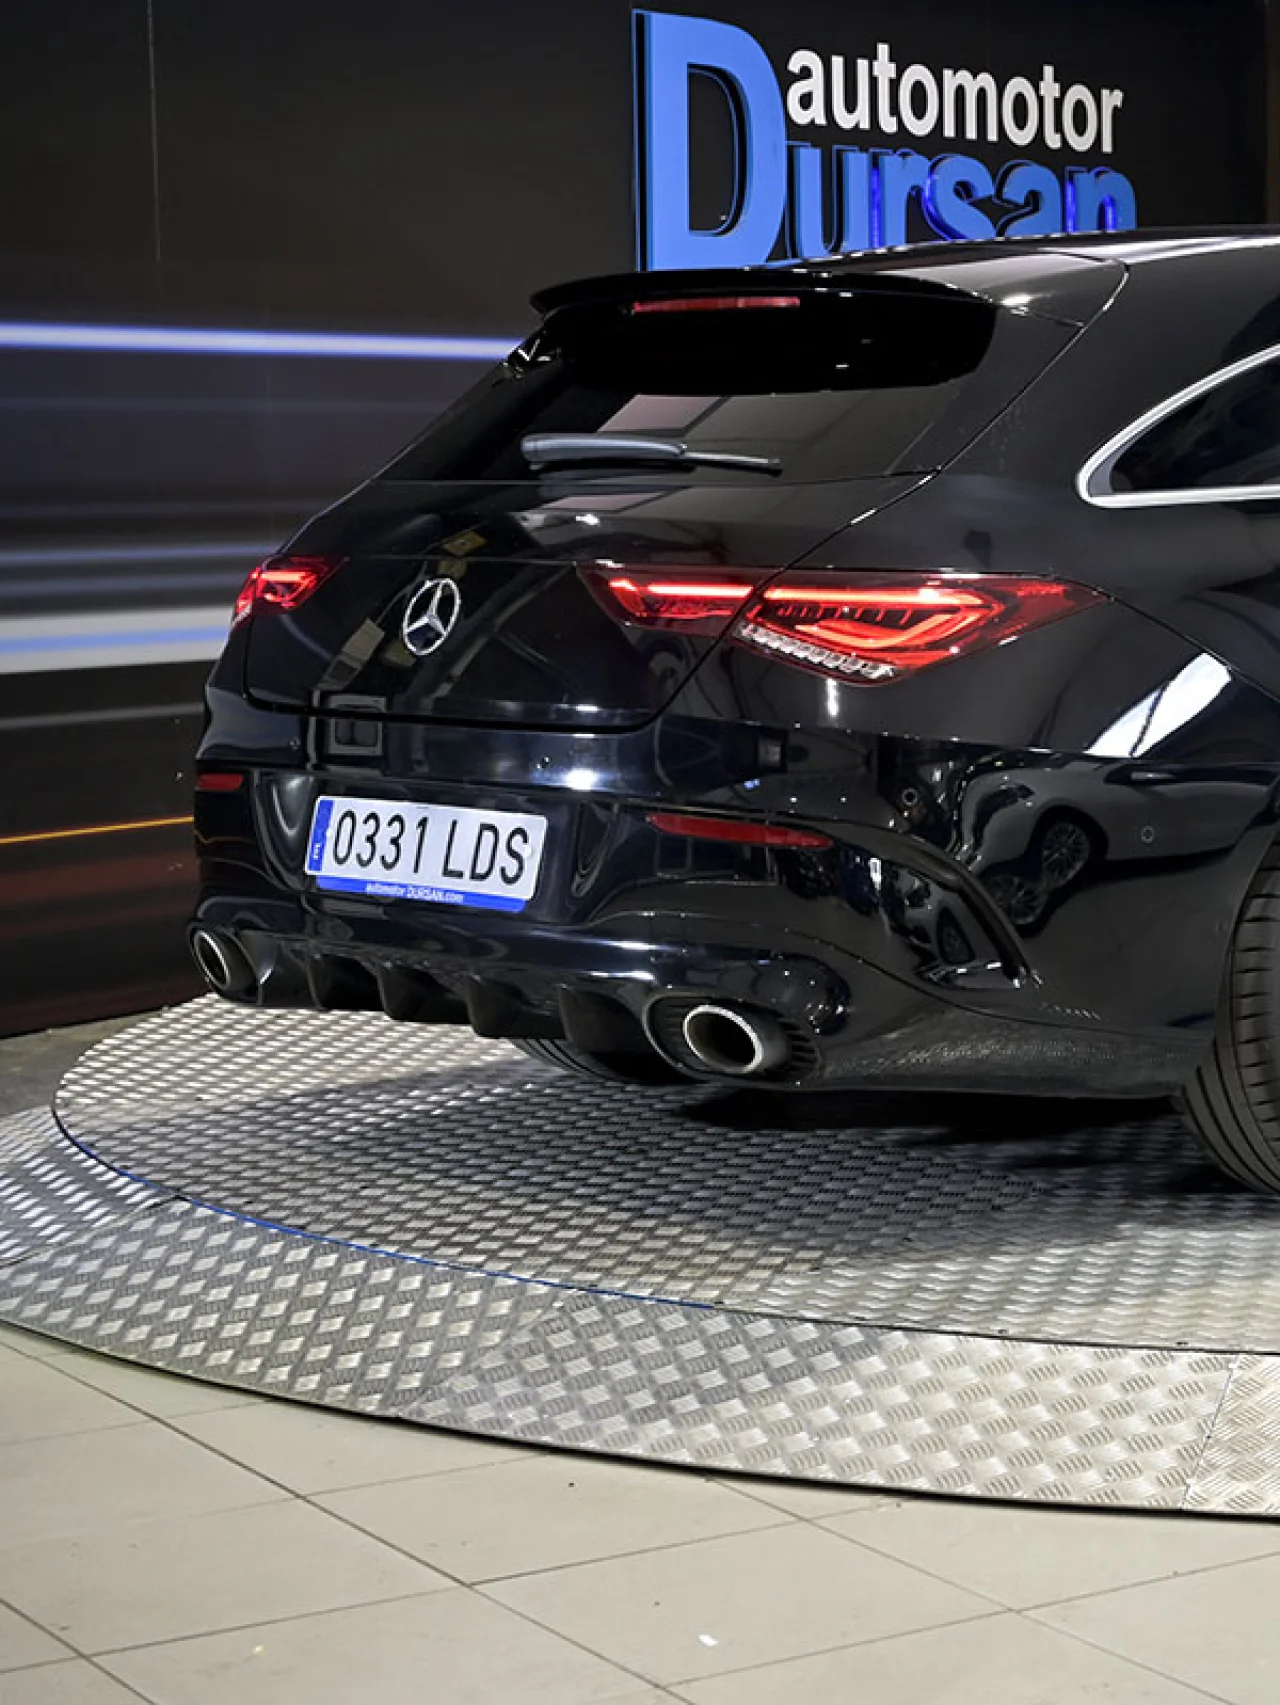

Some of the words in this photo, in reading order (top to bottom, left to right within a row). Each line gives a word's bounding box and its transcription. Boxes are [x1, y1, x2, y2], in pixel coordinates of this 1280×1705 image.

[632, 8, 1137, 273] Dursan
[786, 43, 1123, 154] automotor
[332, 809, 429, 874] 0331
[441, 818, 529, 885] LDS
